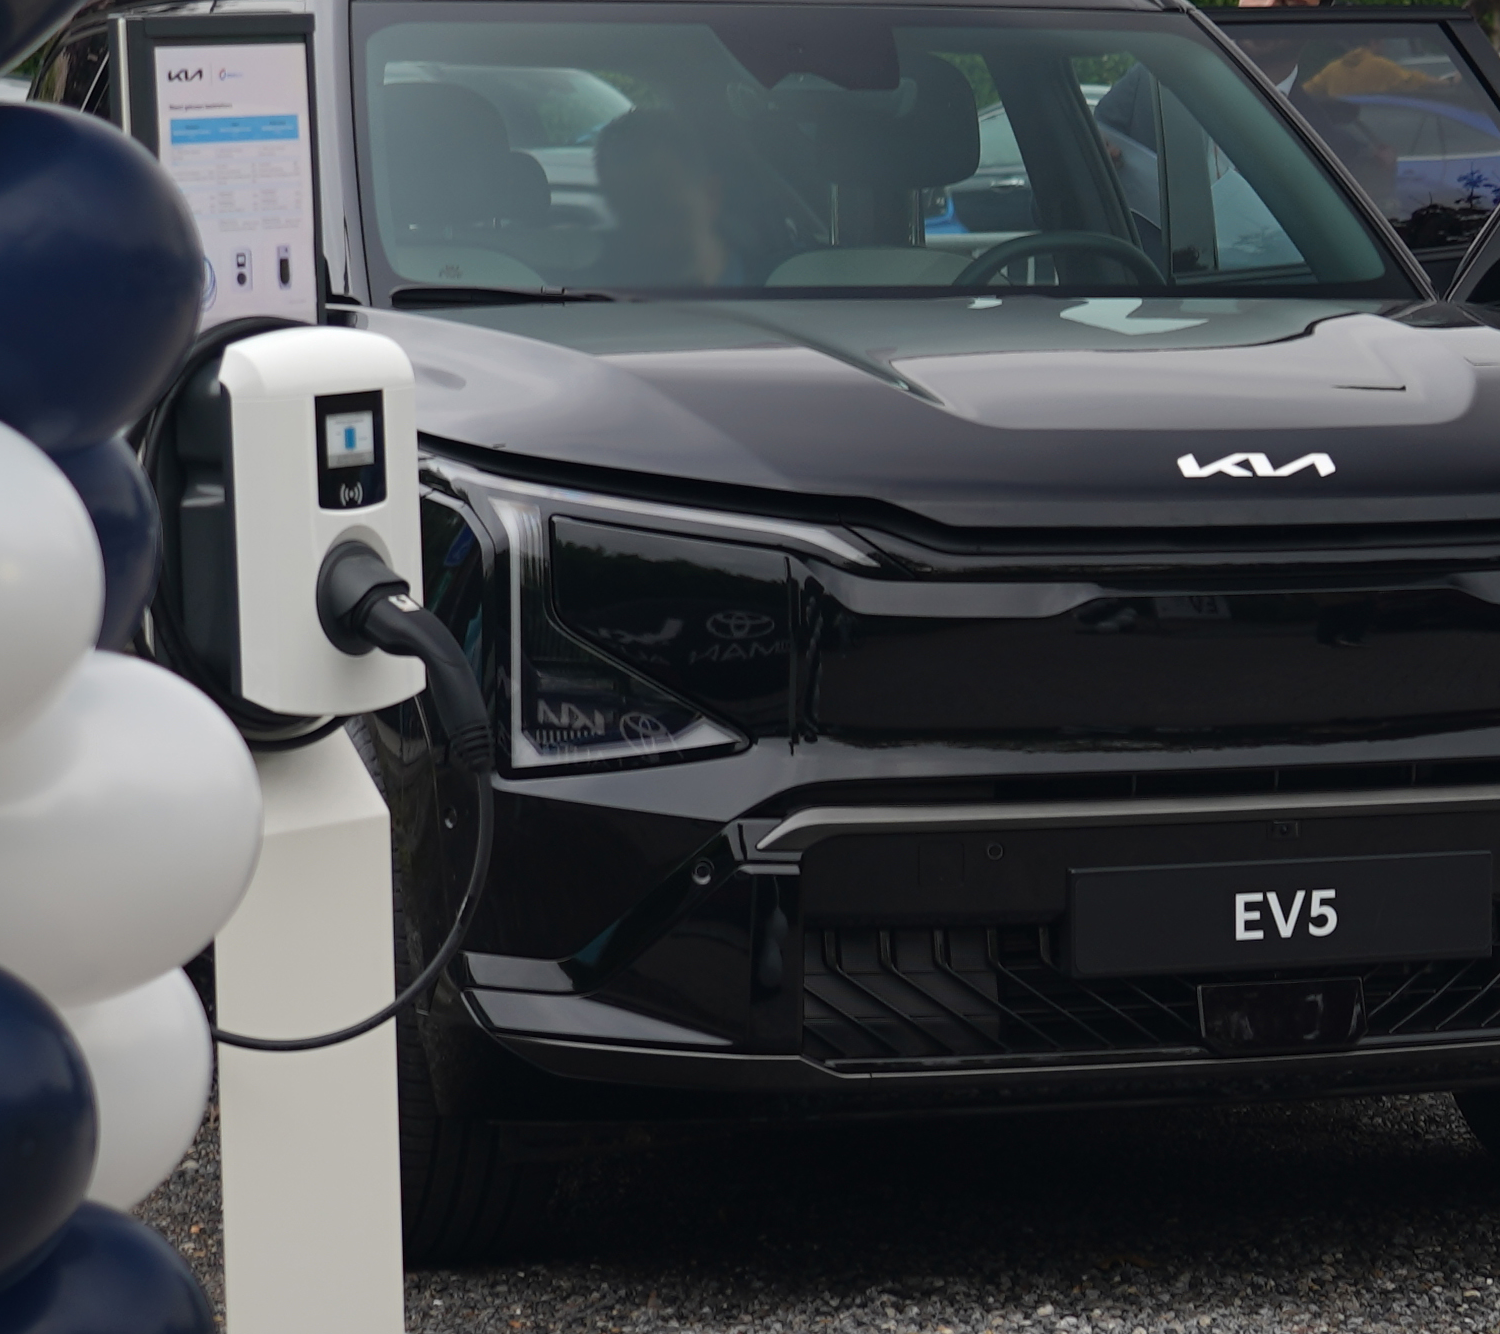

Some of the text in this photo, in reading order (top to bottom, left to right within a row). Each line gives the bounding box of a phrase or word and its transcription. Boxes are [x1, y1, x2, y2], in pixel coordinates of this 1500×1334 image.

[167, 68, 203, 83] KIA
[1177, 453, 1336, 478] KIA
[1235, 888, 1338, 941] EV5
